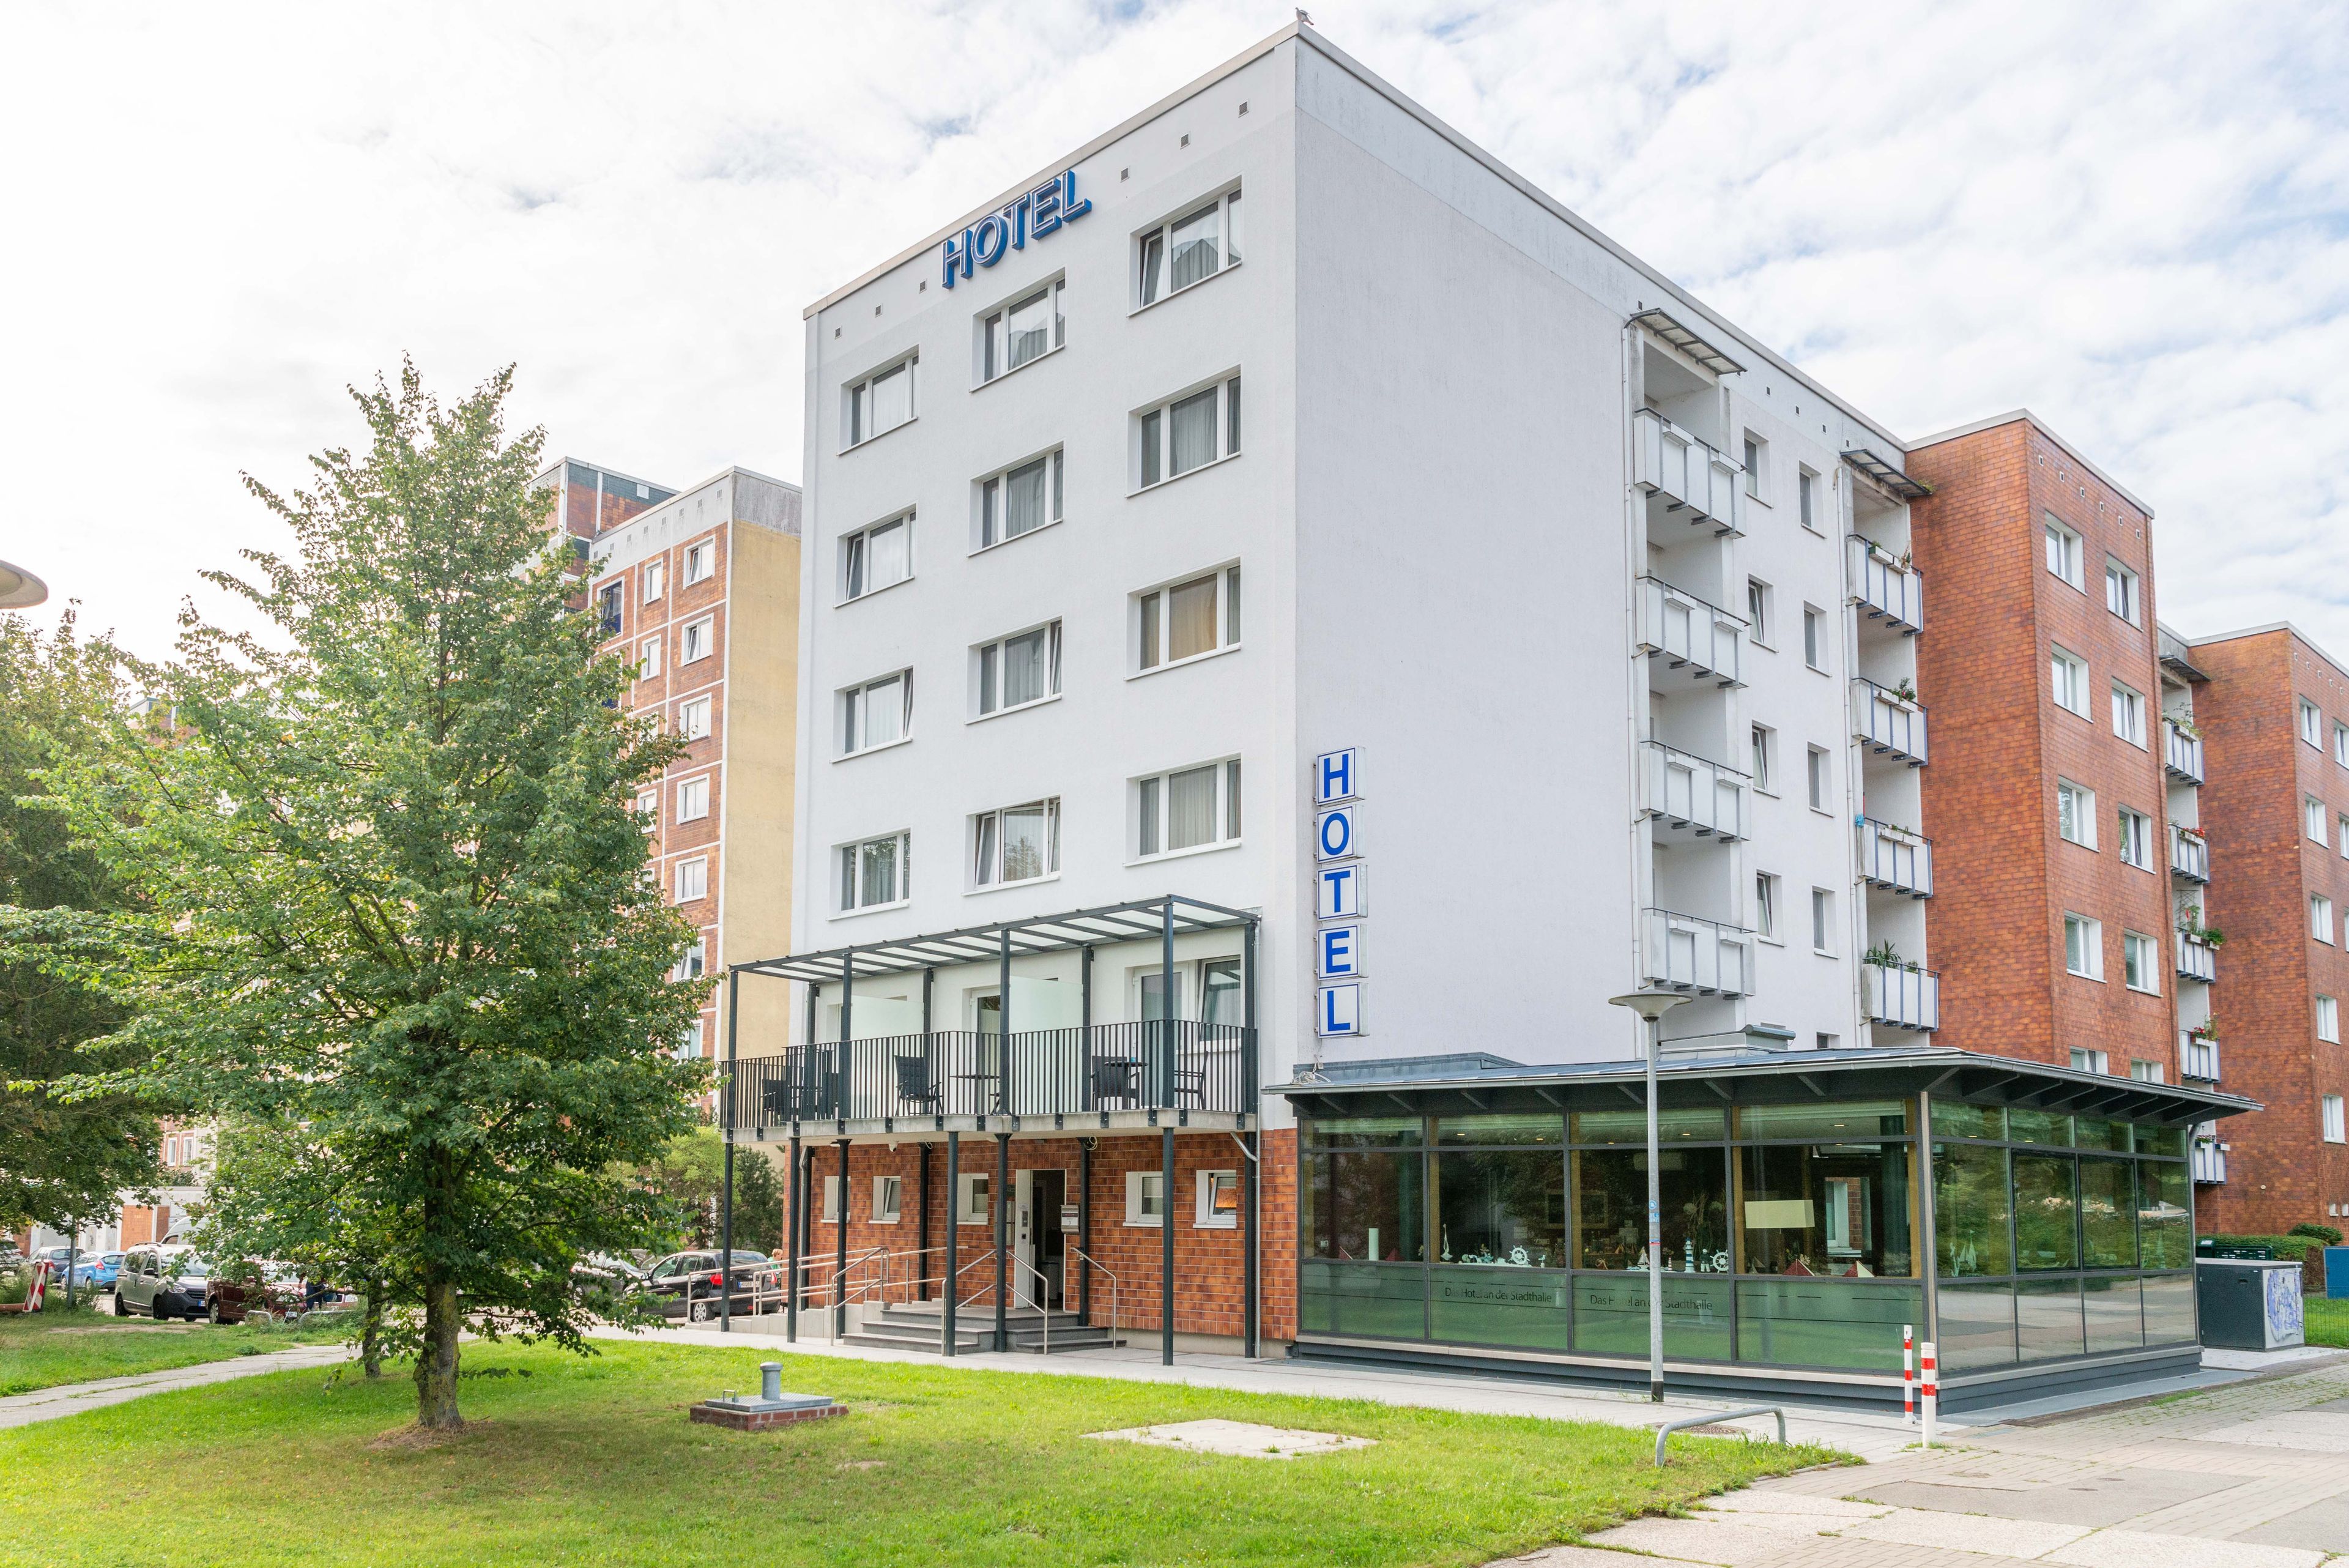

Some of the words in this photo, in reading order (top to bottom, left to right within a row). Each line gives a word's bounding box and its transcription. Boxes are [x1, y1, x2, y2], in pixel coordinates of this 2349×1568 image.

[941, 170, 1093, 289] HOTEL
[1321, 753, 1351, 1032] HOTEL
[1590, 1295, 1606, 1305] Das
[1635, 1299, 1646, 1307] an
